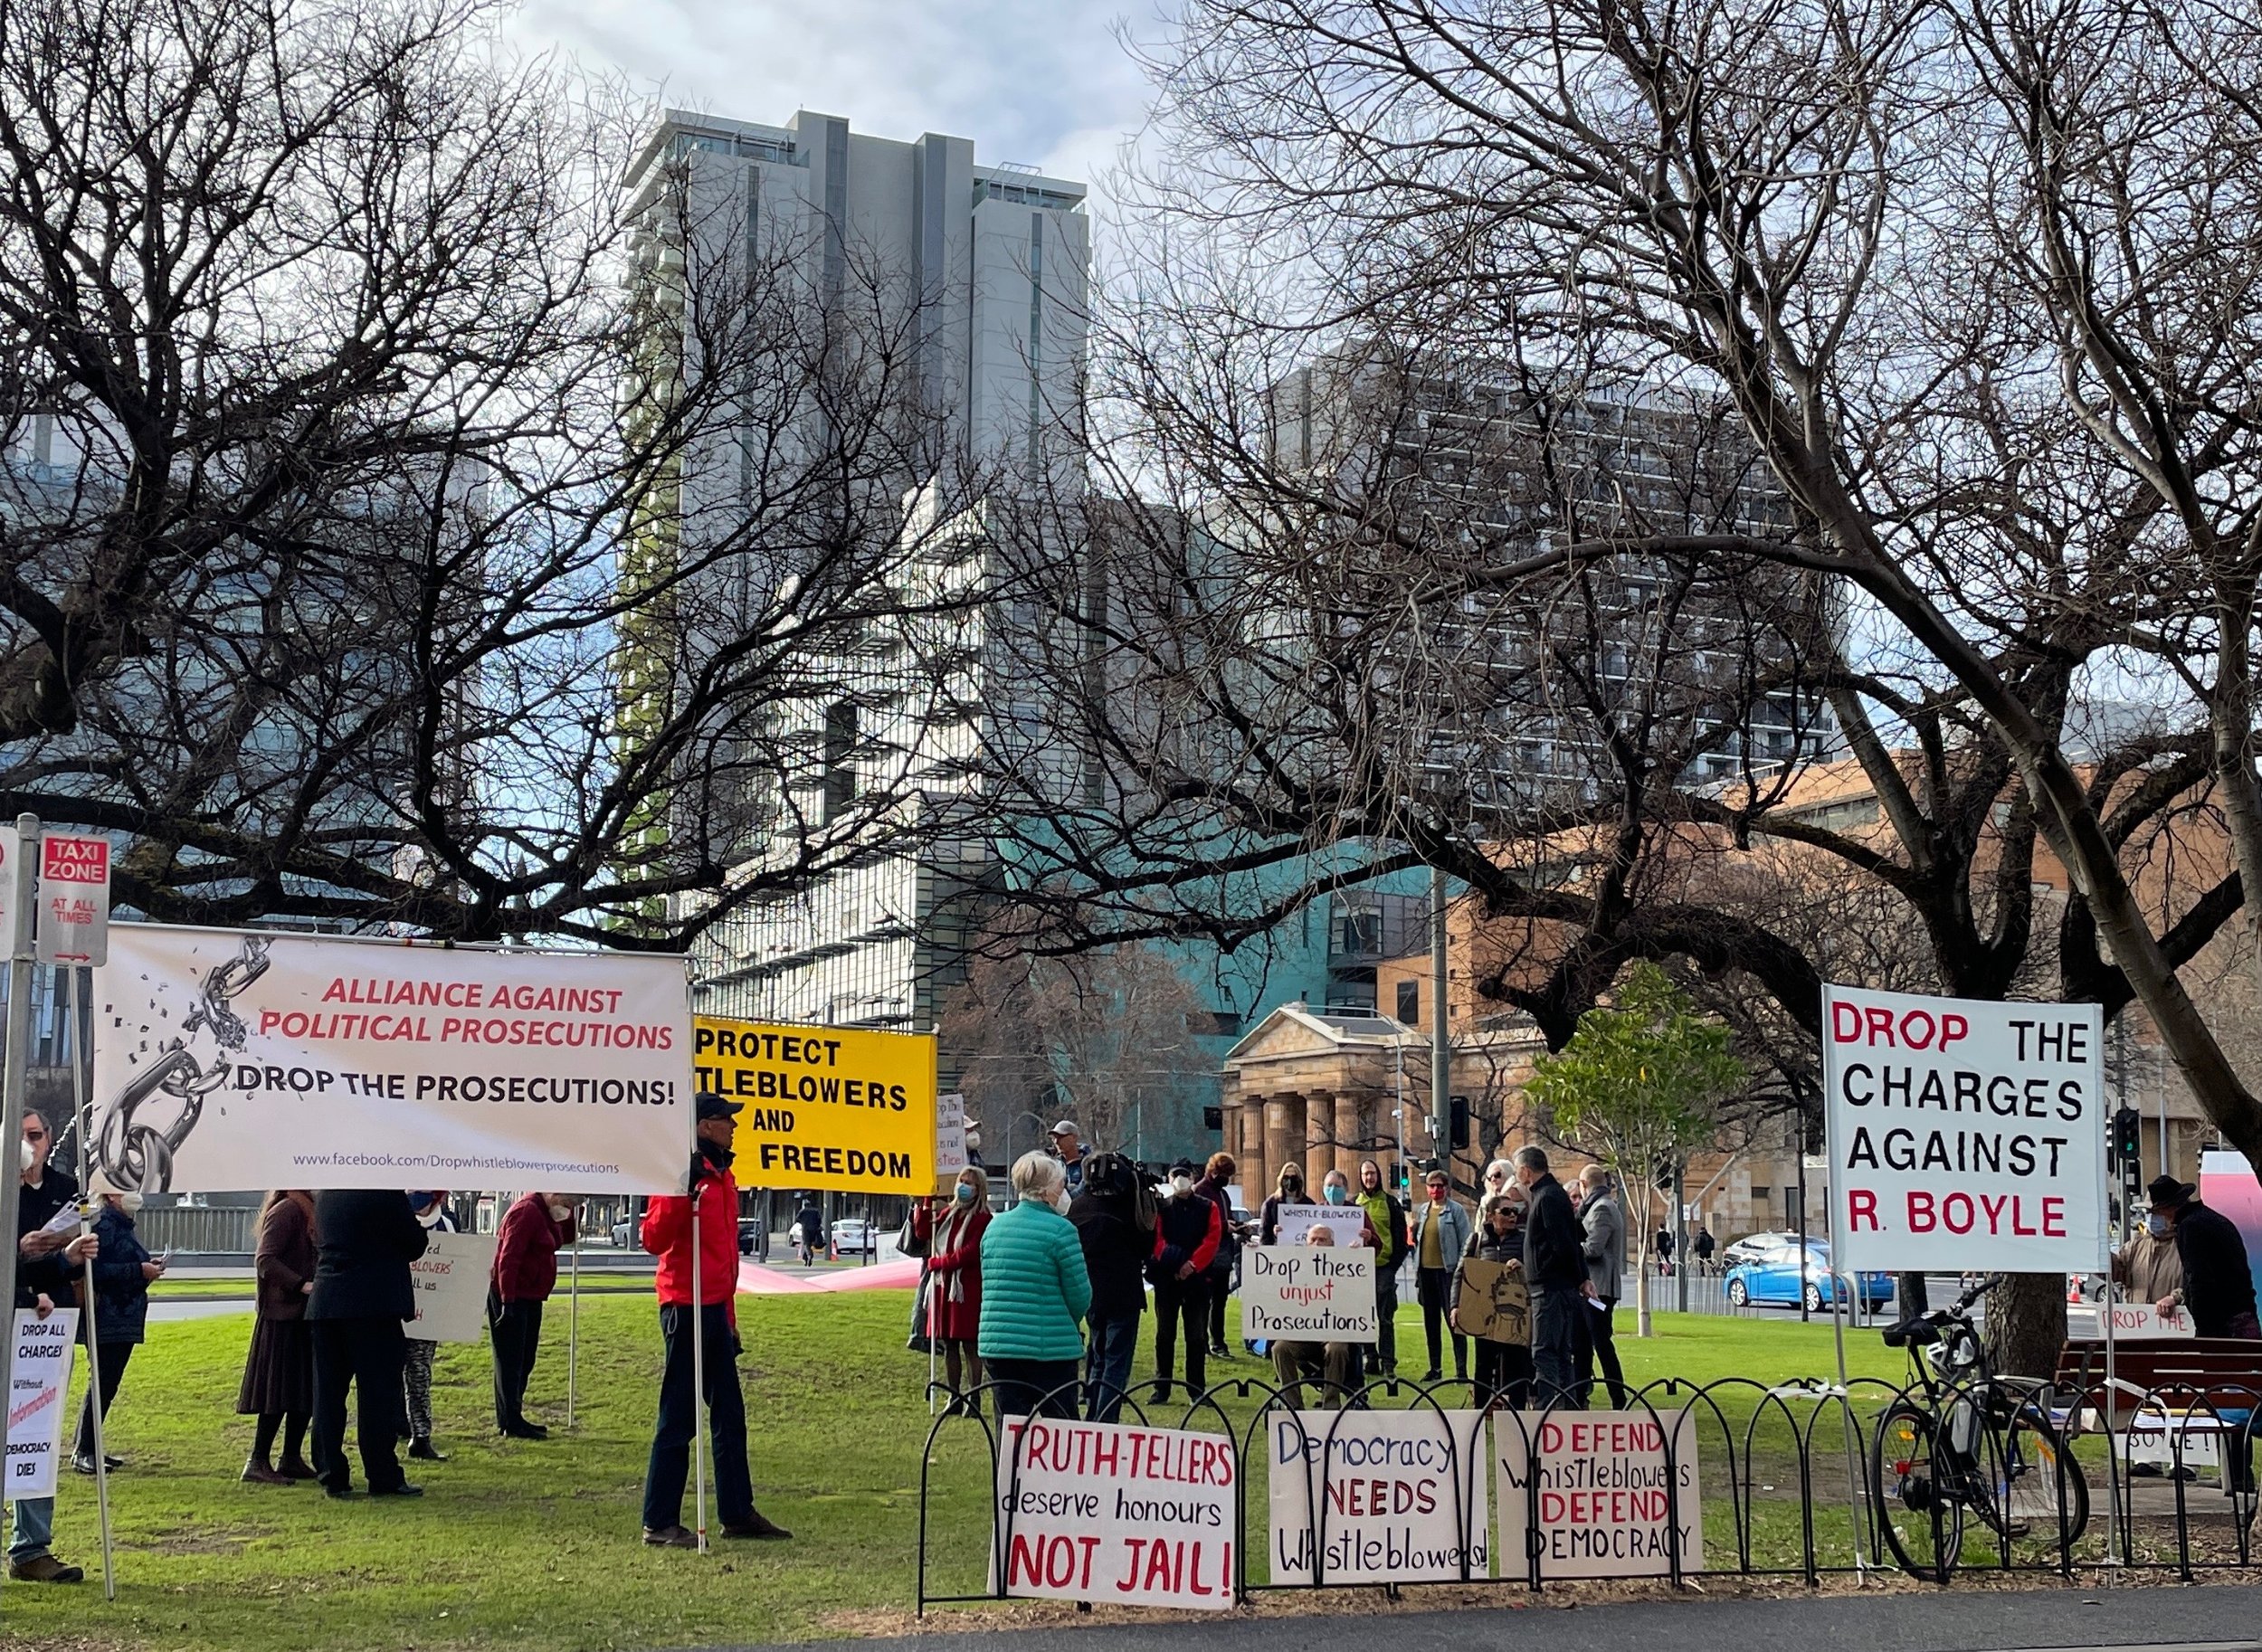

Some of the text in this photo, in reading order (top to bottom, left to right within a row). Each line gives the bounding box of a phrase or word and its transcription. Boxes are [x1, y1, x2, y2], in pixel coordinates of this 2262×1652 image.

[53, 842, 99, 860] TAXI
[47, 861, 102, 881] ZONE
[52, 898, 97, 912] AT ALL
[55, 911, 92, 924] TIMES
[321, 978, 623, 1013] ALLIANCE AGAINST
[260, 1011, 672, 1049] POLITICAL PROSECUTIONS
[1832, 1002, 2088, 1063] DROP THE
[695, 1029, 841, 1067] PROTECT
[237, 1065, 675, 1105] DROP THE PROSECUTIONS!
[1843, 1063, 2082, 1121] CHARGES
[753, 1108, 794, 1132] AND
[293, 1153, 619, 1174] www.facebook.com/Dropwhistleblowerprosecutions
[760, 1144, 910, 1179] FREEDOM
[1848, 1127, 2067, 1177] AGAINST
[1283, 1209, 1362, 1220] WHISTLE-BLOWERS
[1849, 1190, 2066, 1237] R. BOYLE
[1255, 1252, 1367, 1284] Drop these
[425, 1283, 436, 1291] us
[1280, 1279, 1334, 1306] unjust
[22, 1324, 66, 1336] DROP ALL
[1252, 1305, 1375, 1332] Prosecutions!
[19, 1345, 63, 1358] CHARGES
[14, 1379, 43, 1390] Without
[5, 1442, 51, 1455] DEMOCRACY
[1278, 1421, 1455, 1473] Democracy
[1542, 1423, 1664, 1453] DEFEND
[16, 1463, 35, 1476] DIES
[1008, 1424, 1232, 1486] TRUTH-TELLERS
[1502, 1457, 1690, 1489] Whistleblowes
[1003, 1478, 1098, 1517] deserve
[1116, 1488, 1221, 1526] honours
[1326, 1479, 1437, 1516] NEEDS
[1542, 1491, 1668, 1524] DEFEND
[1279, 1527, 1487, 1571] Whstleblowes!
[1525, 1525, 1691, 1560] DEMOCRACY
[1008, 1534, 1230, 1597] NOT JAIL!
